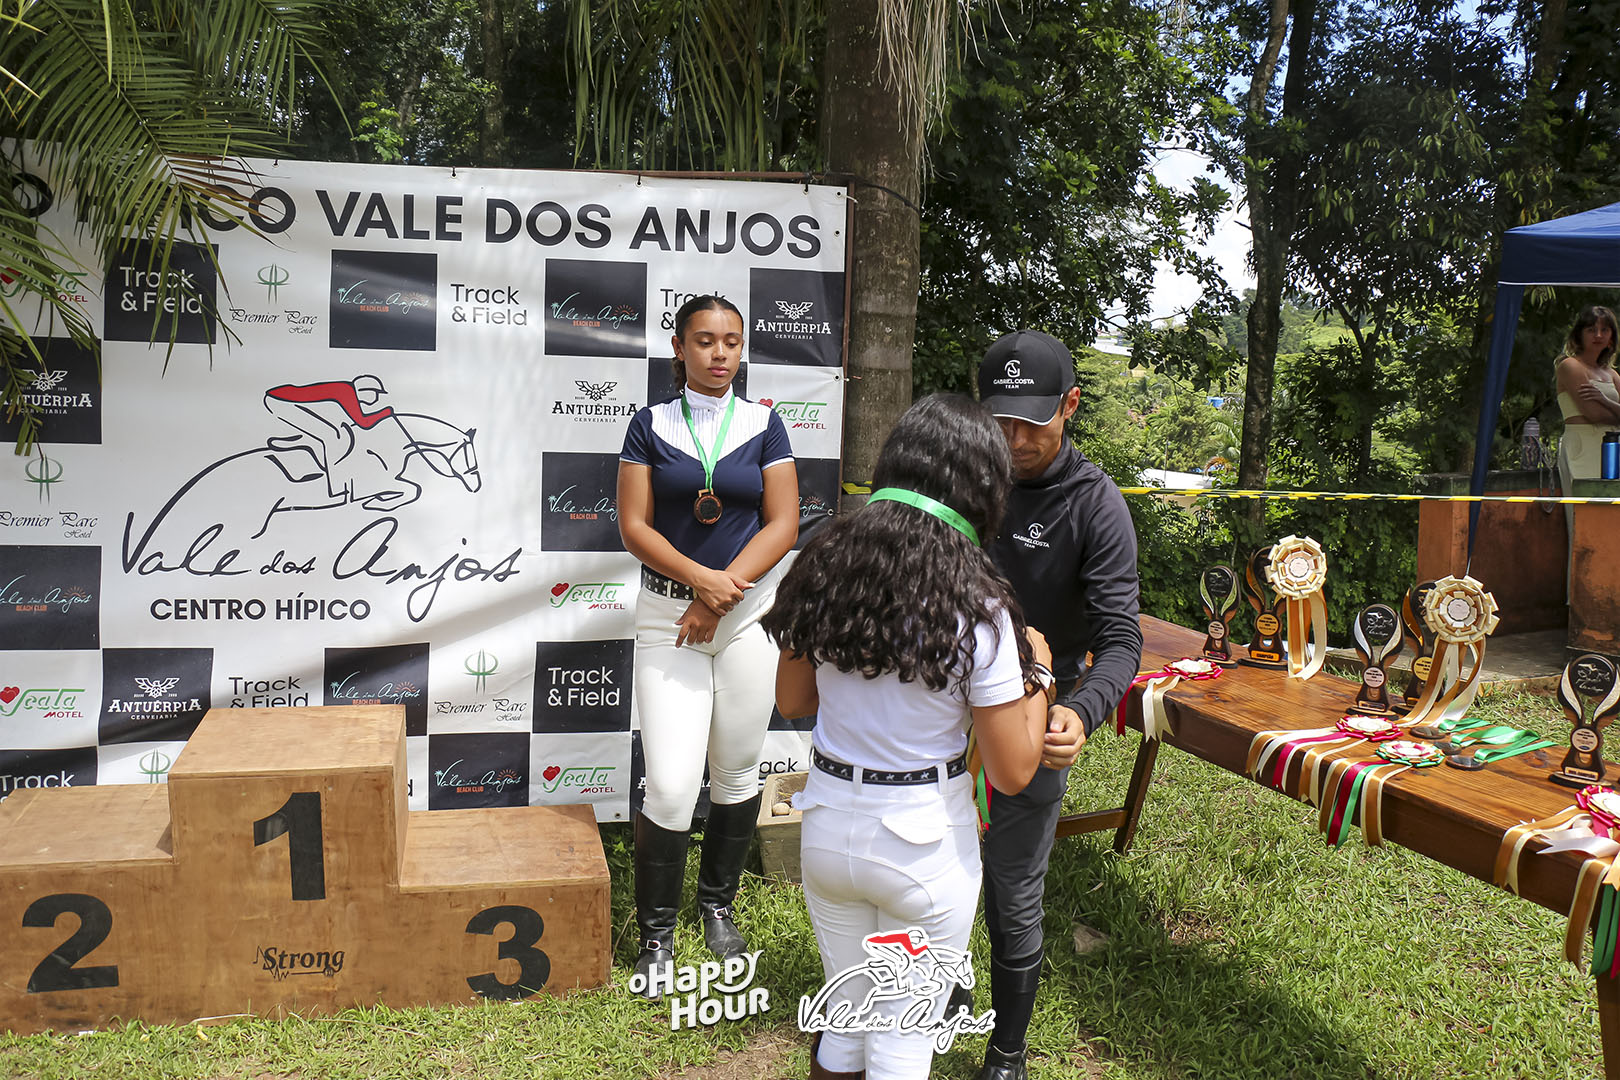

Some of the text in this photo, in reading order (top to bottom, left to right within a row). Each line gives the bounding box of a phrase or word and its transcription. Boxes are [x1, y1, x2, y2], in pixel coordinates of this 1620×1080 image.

[315, 189, 463, 241] VALE
[486, 198, 612, 248] DOS
[629, 206, 822, 259] ANJOS
[121, 291, 202, 314] & Feld
[337, 279, 368, 305] Vale
[386, 292, 430, 315] Anjos
[450, 283, 520, 305] Track
[229, 308, 318, 325] Premier Parc
[452, 305, 528, 326] & Field
[551, 292, 581, 320] Vale
[597, 305, 640, 330] Anjos
[661, 311, 676, 331] &
[791, 422, 827, 430] MOTEL
[547, 485, 577, 513] Vale
[0, 511, 98, 528] Premier Parc
[123, 511, 523, 623] Vale dos Anjos
[44, 587, 92, 614] Anjos
[150, 591, 372, 621] CENTRO HÍPICO
[228, 676, 302, 695] Track
[547, 666, 614, 685] Track
[330, 670, 361, 699] Vale
[378, 682, 421, 705] Anjos
[547, 688, 620, 707] & Field
[252, 692, 309, 709] Field
[434, 698, 528, 715] Premier Parc
[43, 711, 84, 719] MOTEL
[434, 759, 464, 787] Vale
[480, 770, 522, 793] Anjos
[759, 757, 799, 775] ack
[0, 770, 75, 792] Track
[252, 791, 327, 901] 1
[21, 892, 120, 994] 2
[464, 904, 552, 1001] 3
[262, 946, 346, 974] Strong
